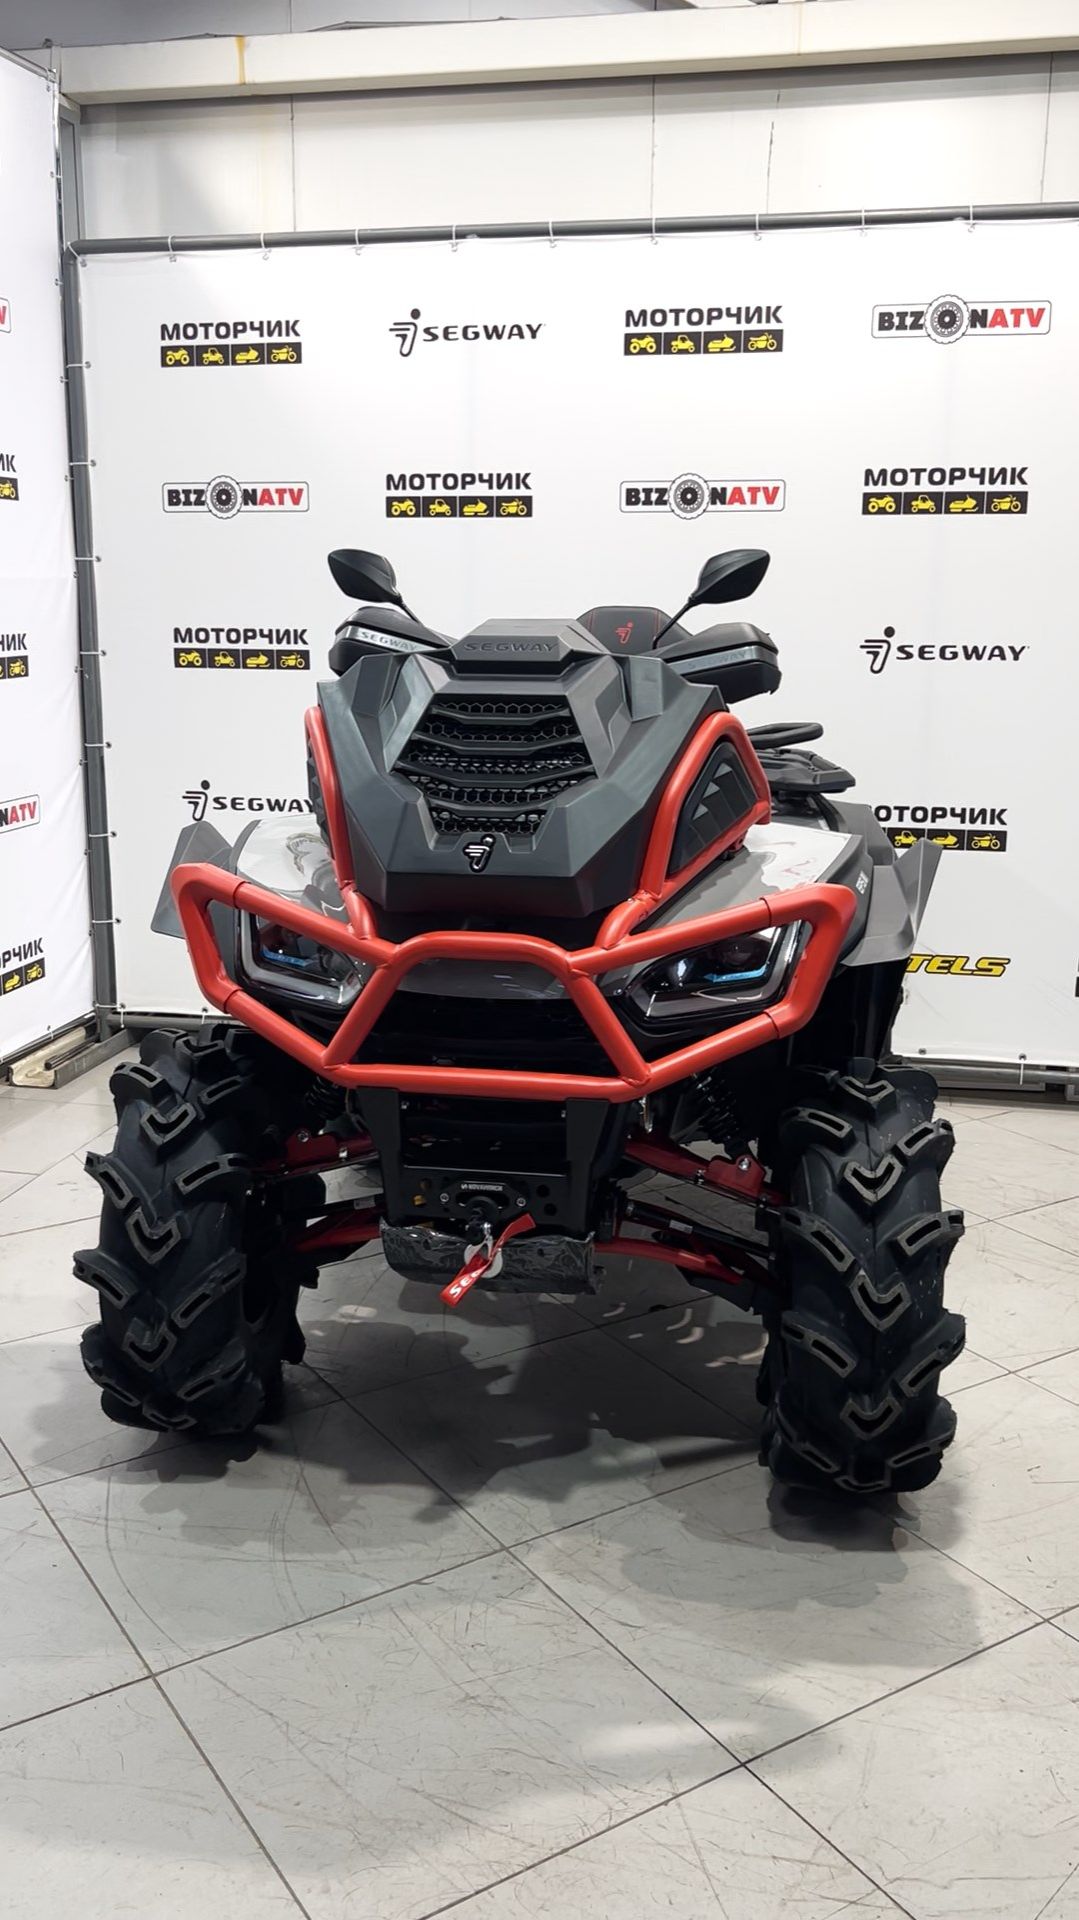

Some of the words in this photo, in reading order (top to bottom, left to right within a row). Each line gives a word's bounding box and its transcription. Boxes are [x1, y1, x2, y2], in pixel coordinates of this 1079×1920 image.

[625, 305, 783, 328] МОТОРЧИК
[160, 319, 301, 341] МОТОРЧИК
[423, 323, 542, 342] SEGWAY
[386, 472, 532, 491] МОТОРЧИК
[864, 466, 1028, 487] МОТОРЧИК
[173, 627, 309, 646] МОТОРЧИК
[464, 641, 558, 652] SEGWAY
[895, 644, 1027, 662] SEGWAY
[212, 796, 314, 813] SEGWAY
[873, 805, 1008, 826] ОТОРЧИК
[0, 936, 44, 968] РЧИК
[906, 953, 1011, 977] TELS
